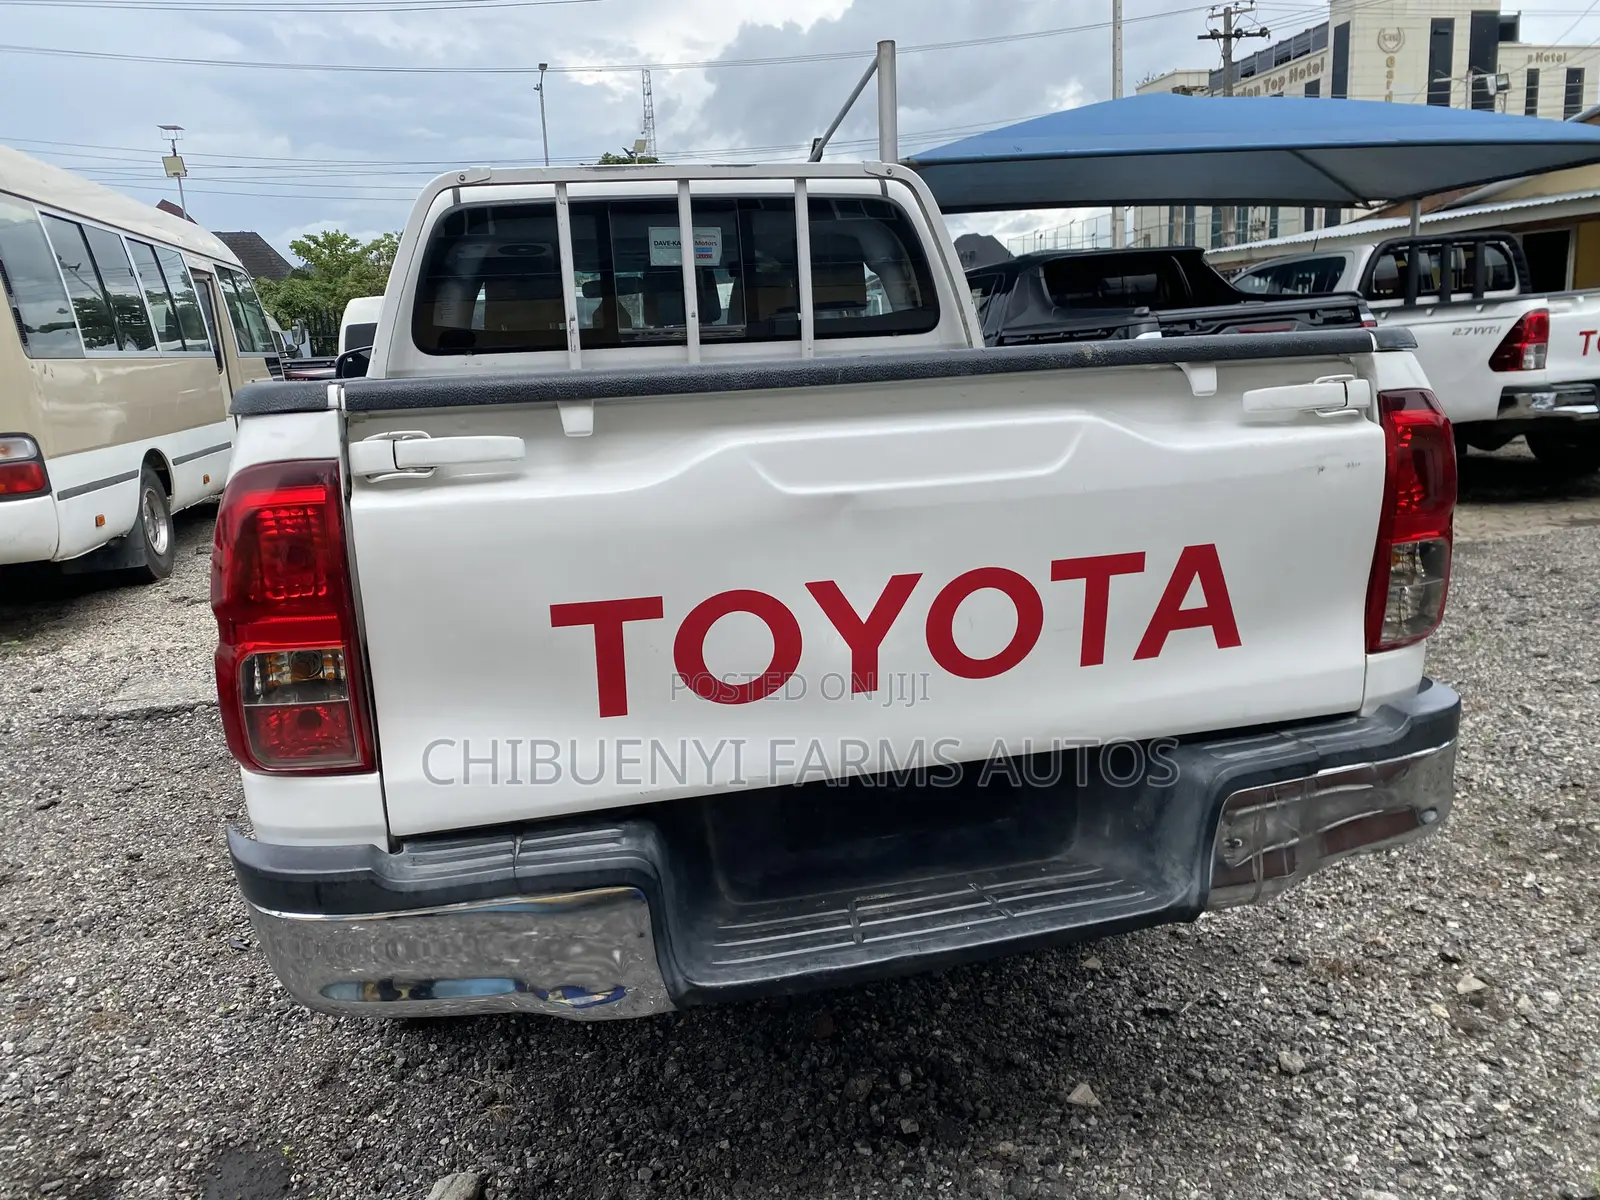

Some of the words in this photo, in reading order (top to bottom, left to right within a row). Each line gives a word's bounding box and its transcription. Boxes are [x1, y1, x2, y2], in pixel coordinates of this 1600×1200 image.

[1535, 51, 1567, 63] Hotel
[1263, 75, 1286, 93] Top
[1289, 57, 1325, 84] Hotel
[1579, 329, 1600, 357] T
[551, 543, 1241, 718] TOYOTA
